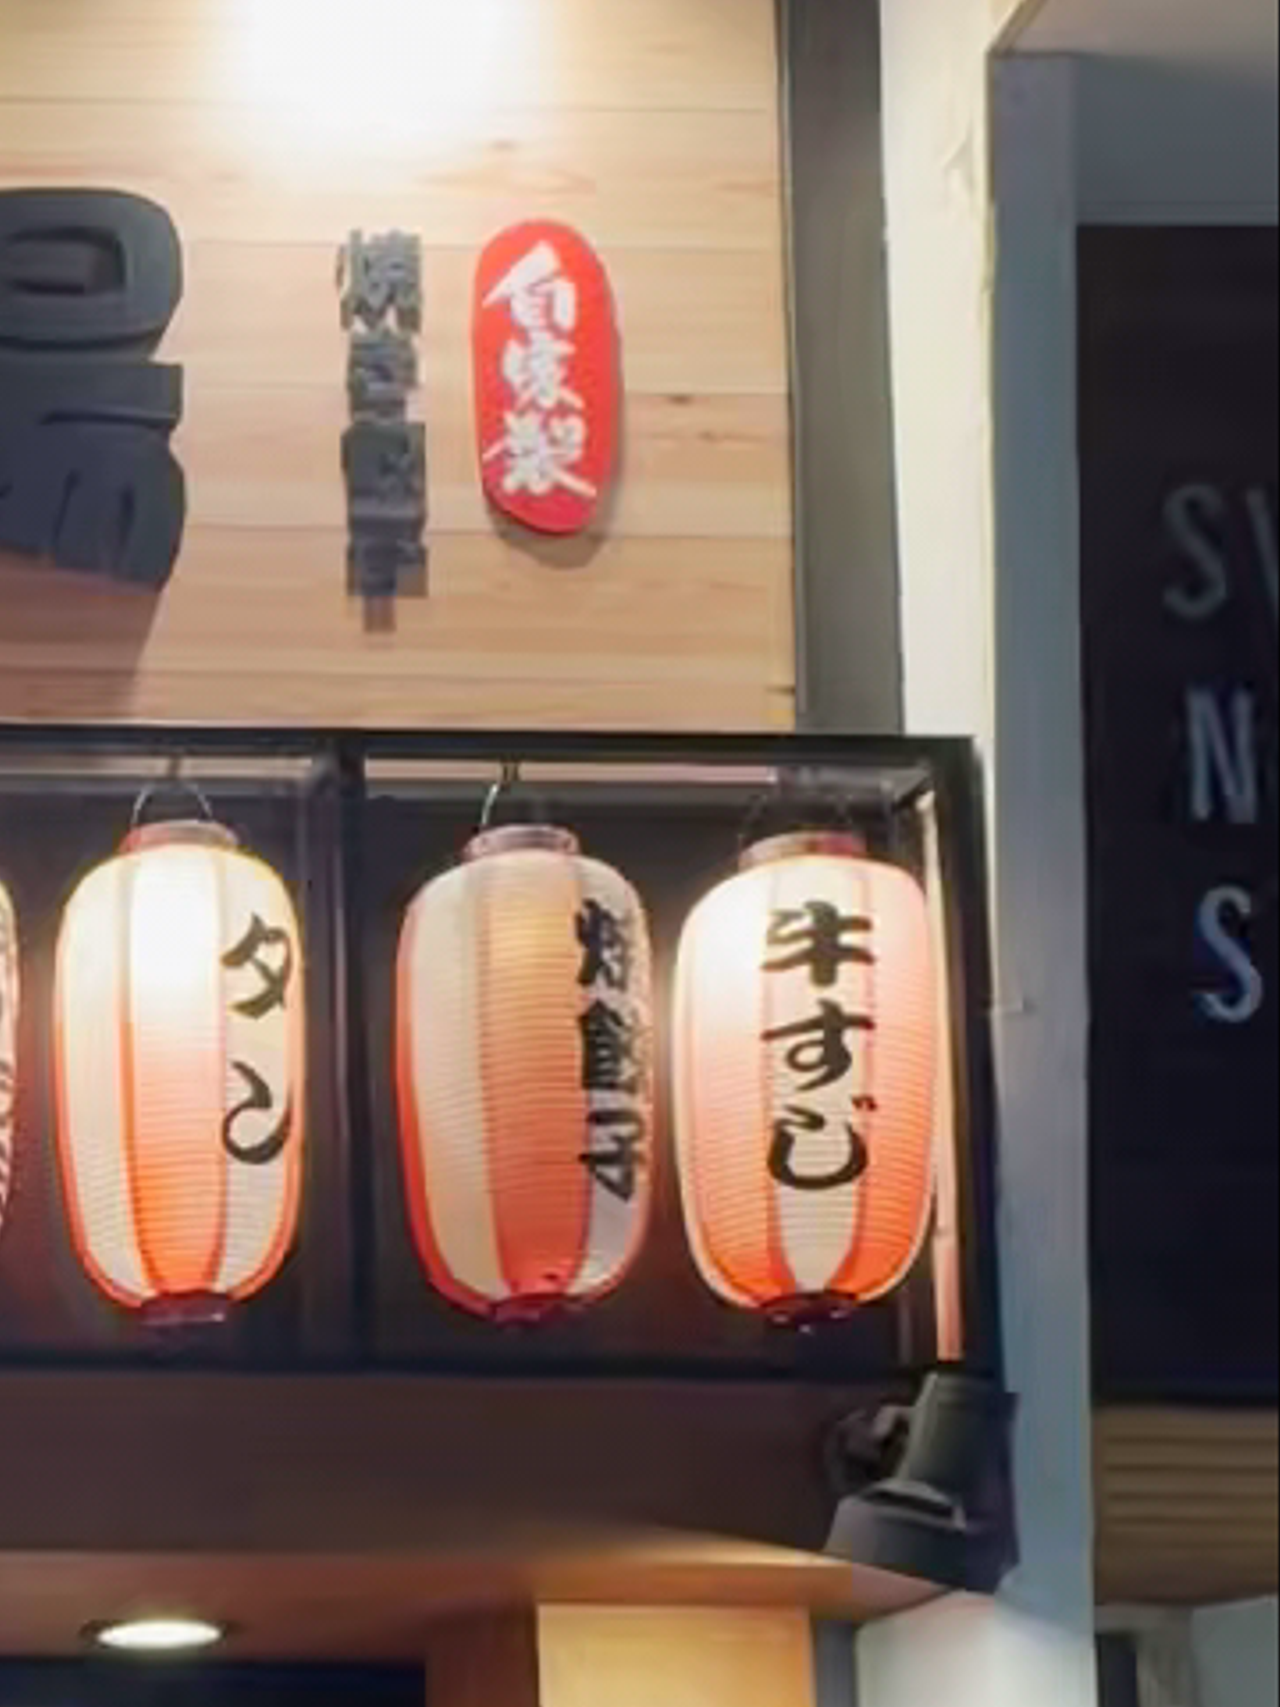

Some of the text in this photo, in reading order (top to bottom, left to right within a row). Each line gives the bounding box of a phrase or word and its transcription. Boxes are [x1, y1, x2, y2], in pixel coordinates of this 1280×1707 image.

[482, 239, 600, 497] 自家製
[220, 910, 293, 1166] タン
[760, 899, 878, 1191] 牛すじ
